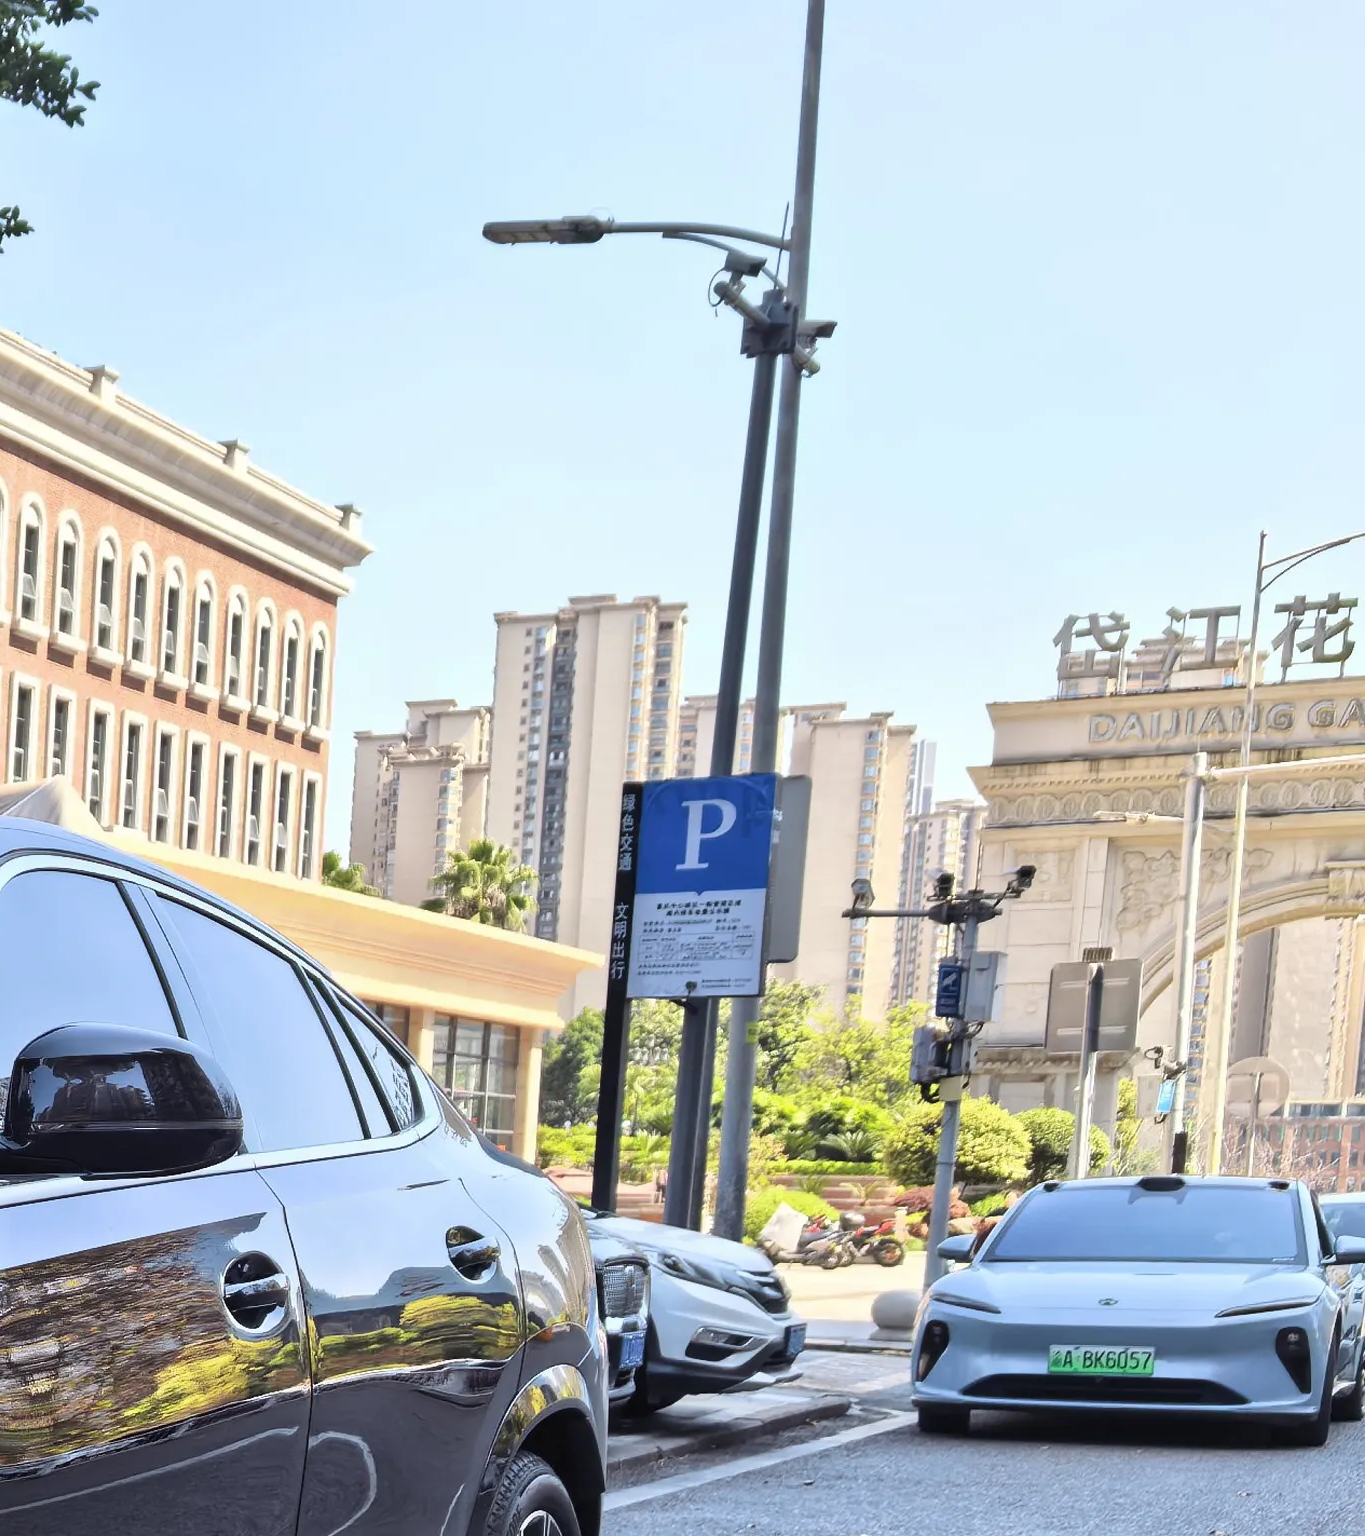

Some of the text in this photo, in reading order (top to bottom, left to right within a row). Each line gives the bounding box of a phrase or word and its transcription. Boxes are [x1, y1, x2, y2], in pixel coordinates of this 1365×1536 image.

[1088, 702, 1295, 743] DAIJIANG
[676, 799, 737, 870] P
[610, 794, 636, 980] 绿色交通 文明出行
